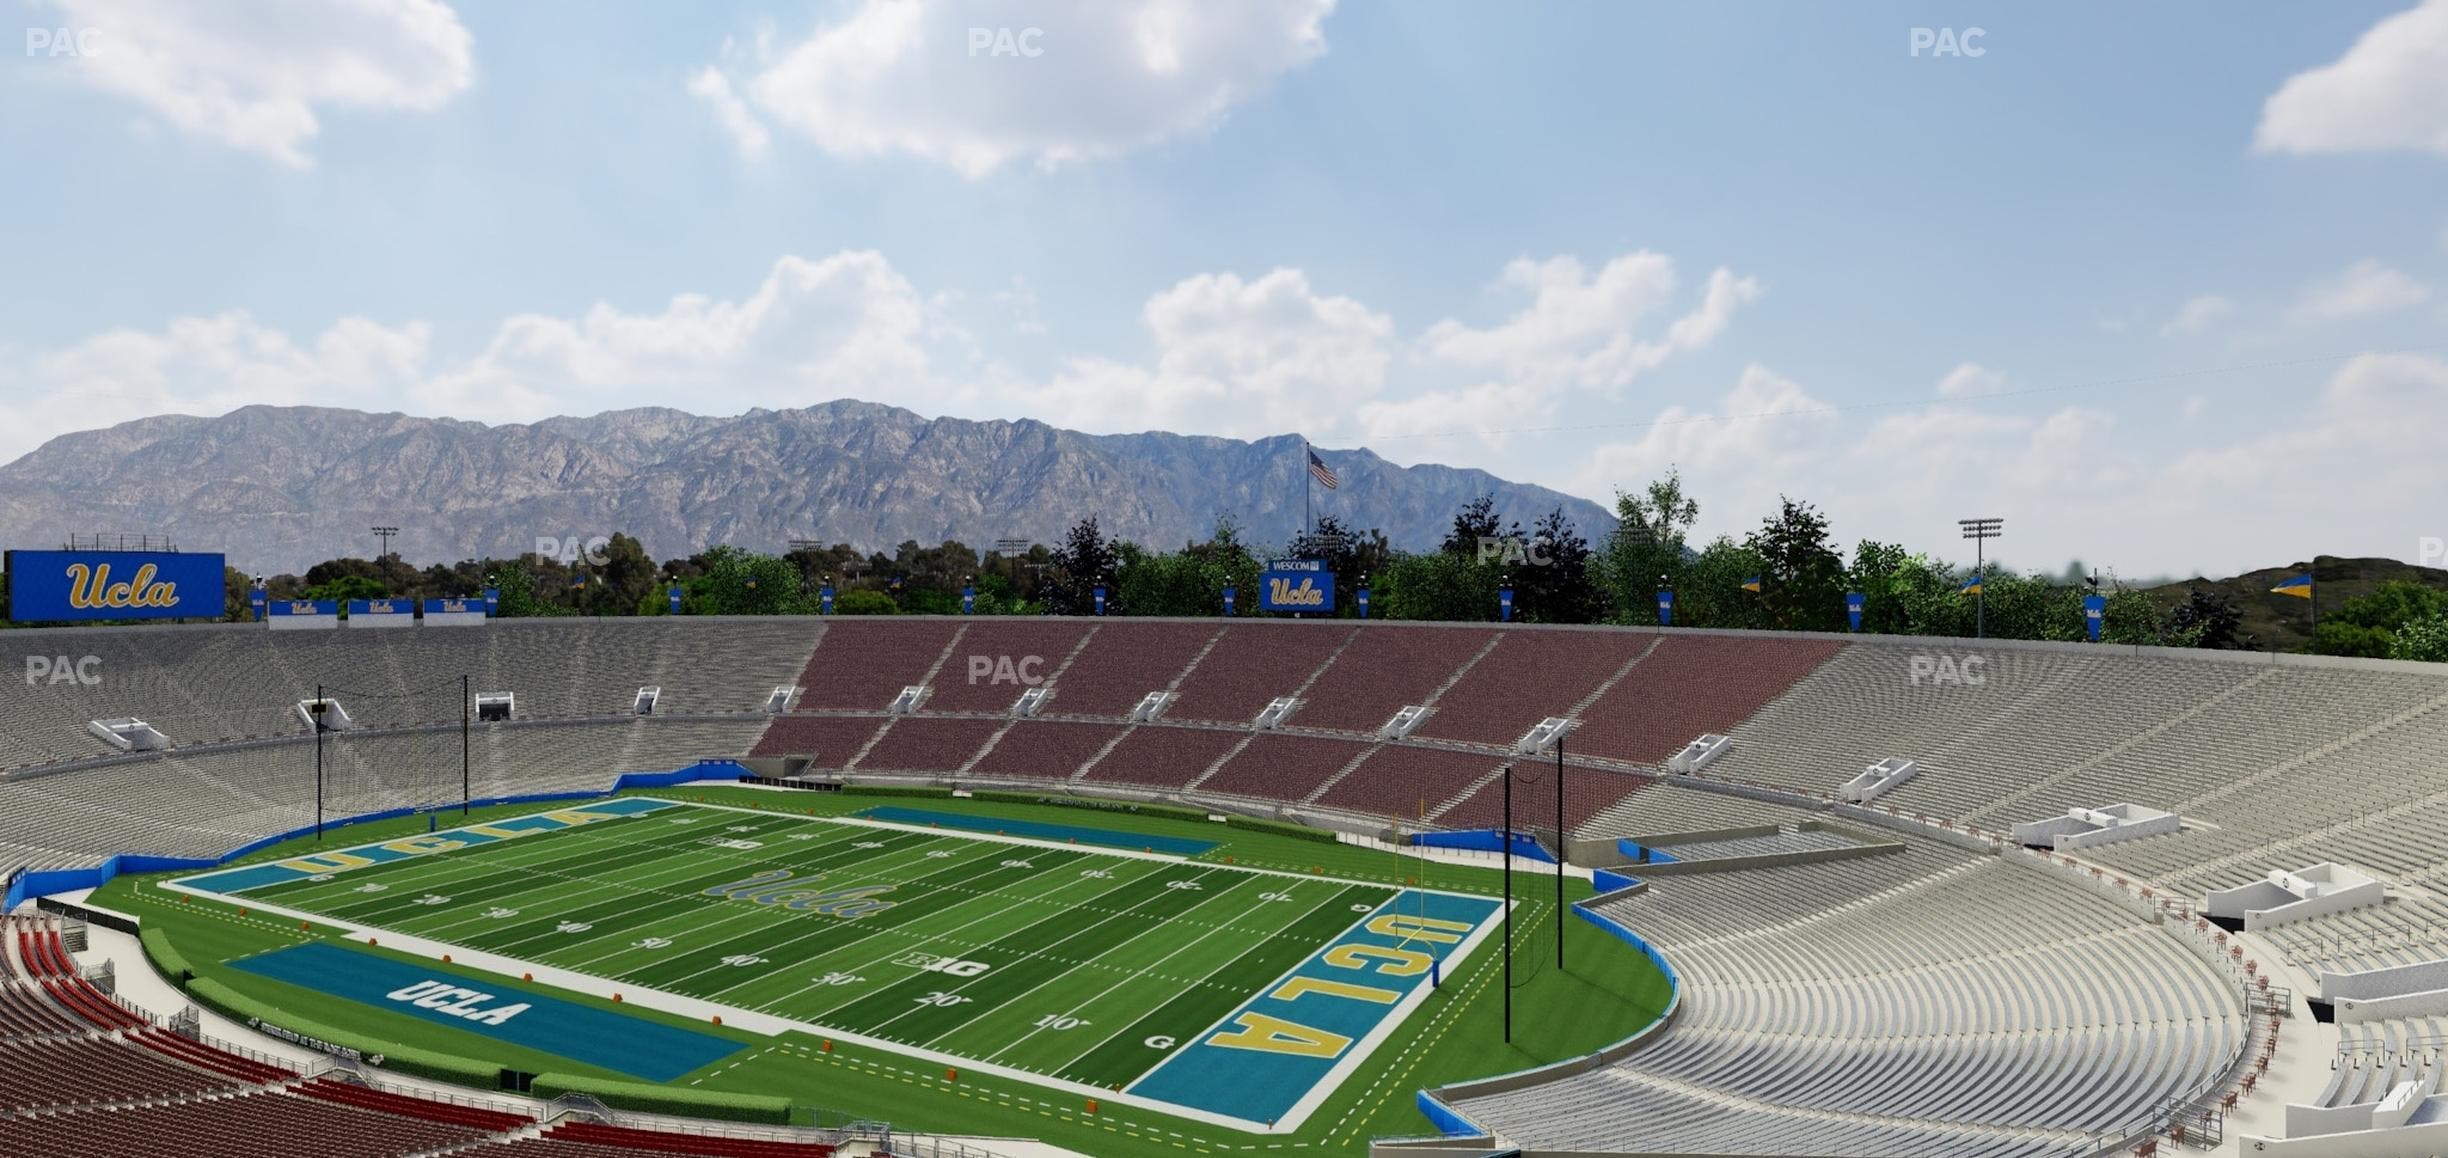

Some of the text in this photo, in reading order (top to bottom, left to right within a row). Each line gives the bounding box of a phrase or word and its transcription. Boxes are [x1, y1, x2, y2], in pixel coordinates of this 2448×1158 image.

[1273, 560, 1310, 571] WESCOM
[66, 563, 180, 609] Ucla
[1269, 577, 1324, 605] Ucla
[276, 811, 622, 873] UCLA
[811, 971, 856, 986] 30
[1204, 914, 1475, 1060] UCLA
[385, 979, 533, 1026] UCLA
[913, 991, 962, 1007] 20
[1032, 1014, 1080, 1031] 10
[1144, 1034, 1176, 1050] G
